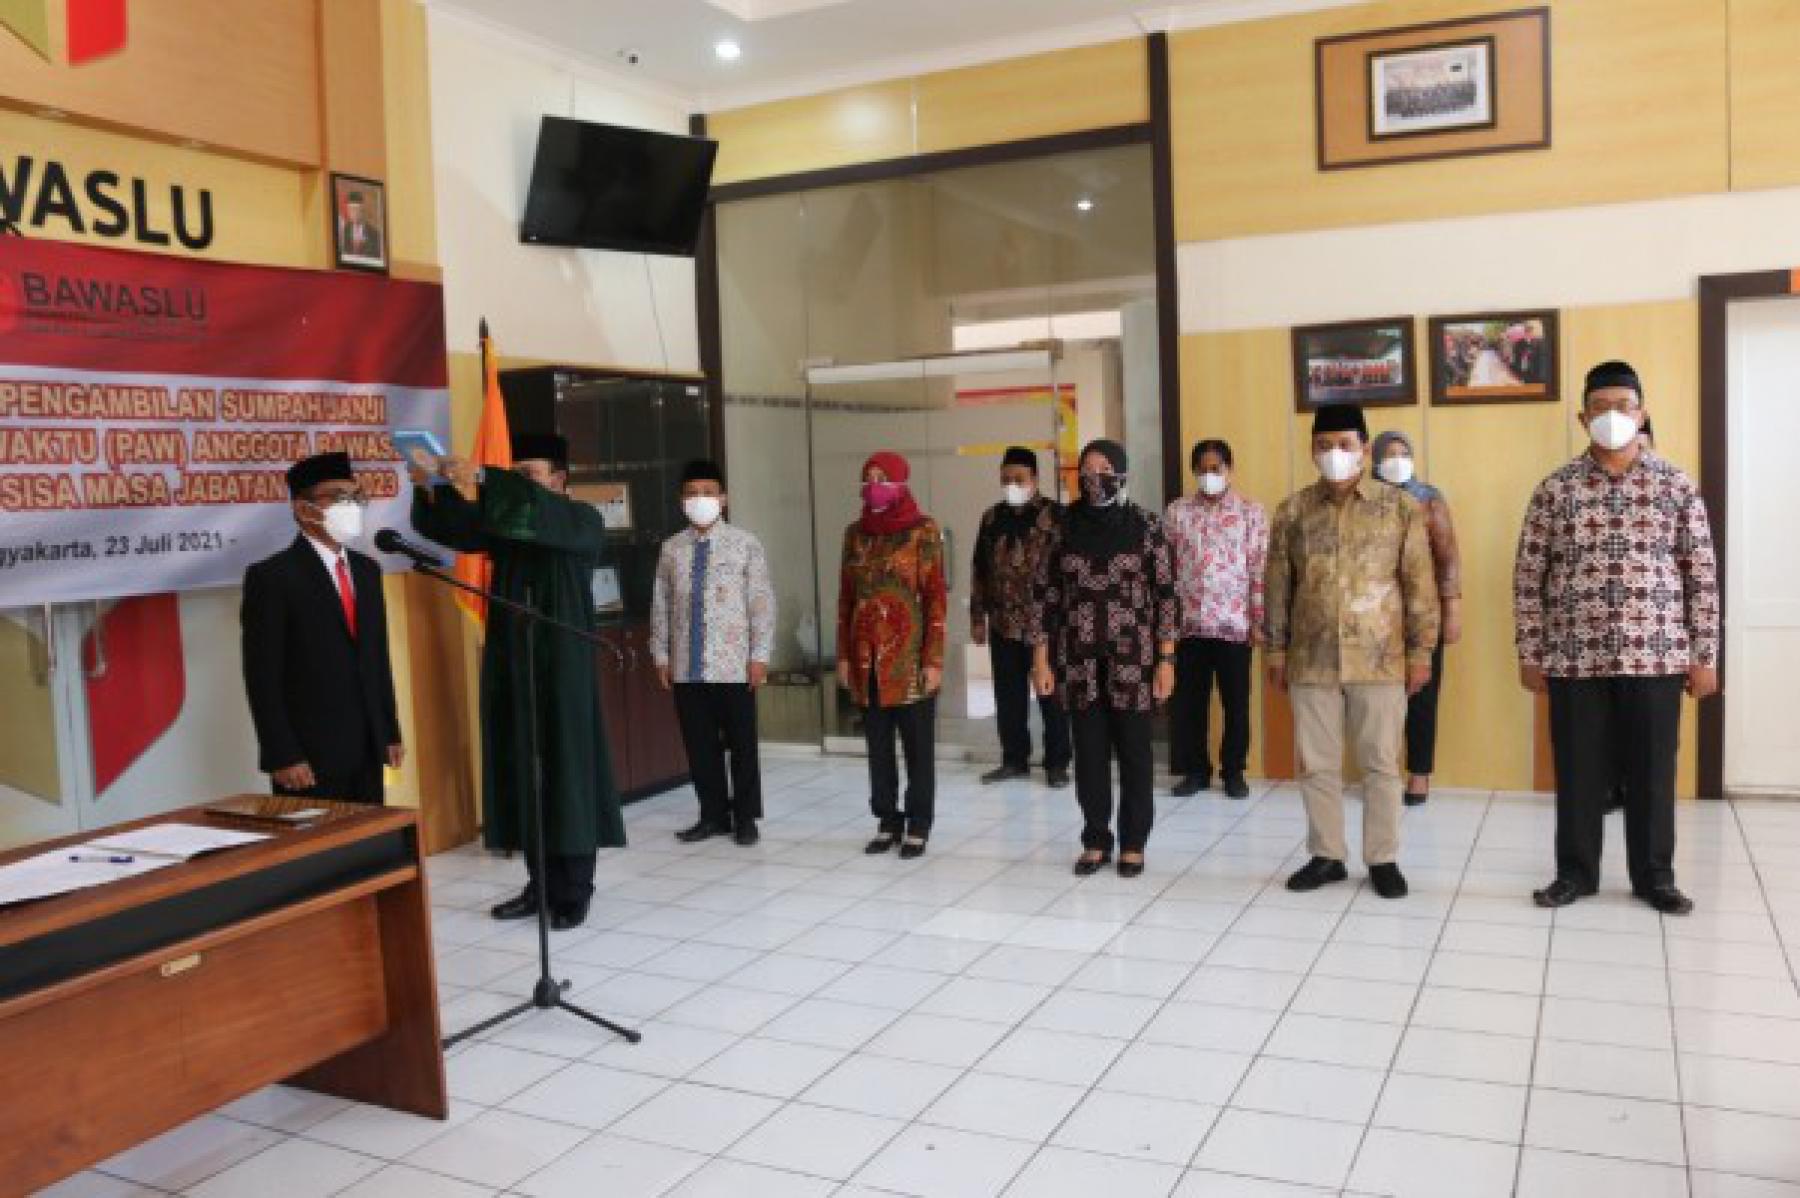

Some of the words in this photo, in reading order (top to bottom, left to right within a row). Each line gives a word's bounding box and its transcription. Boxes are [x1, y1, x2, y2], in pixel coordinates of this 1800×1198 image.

[23, 272, 206, 321] BAWASLU
[0, 382, 216, 422] PENGAMBILAN
[0, 428, 97, 464] AKTU
[106, 429, 187, 470] (PAW)
[1, 473, 76, 511] SISA
[81, 473, 170, 509] MASA
[176, 471, 288, 507] JABATAN
[104, 535, 130, 557] 23
[135, 532, 172, 554] Juli
[178, 530, 222, 551] 2021
